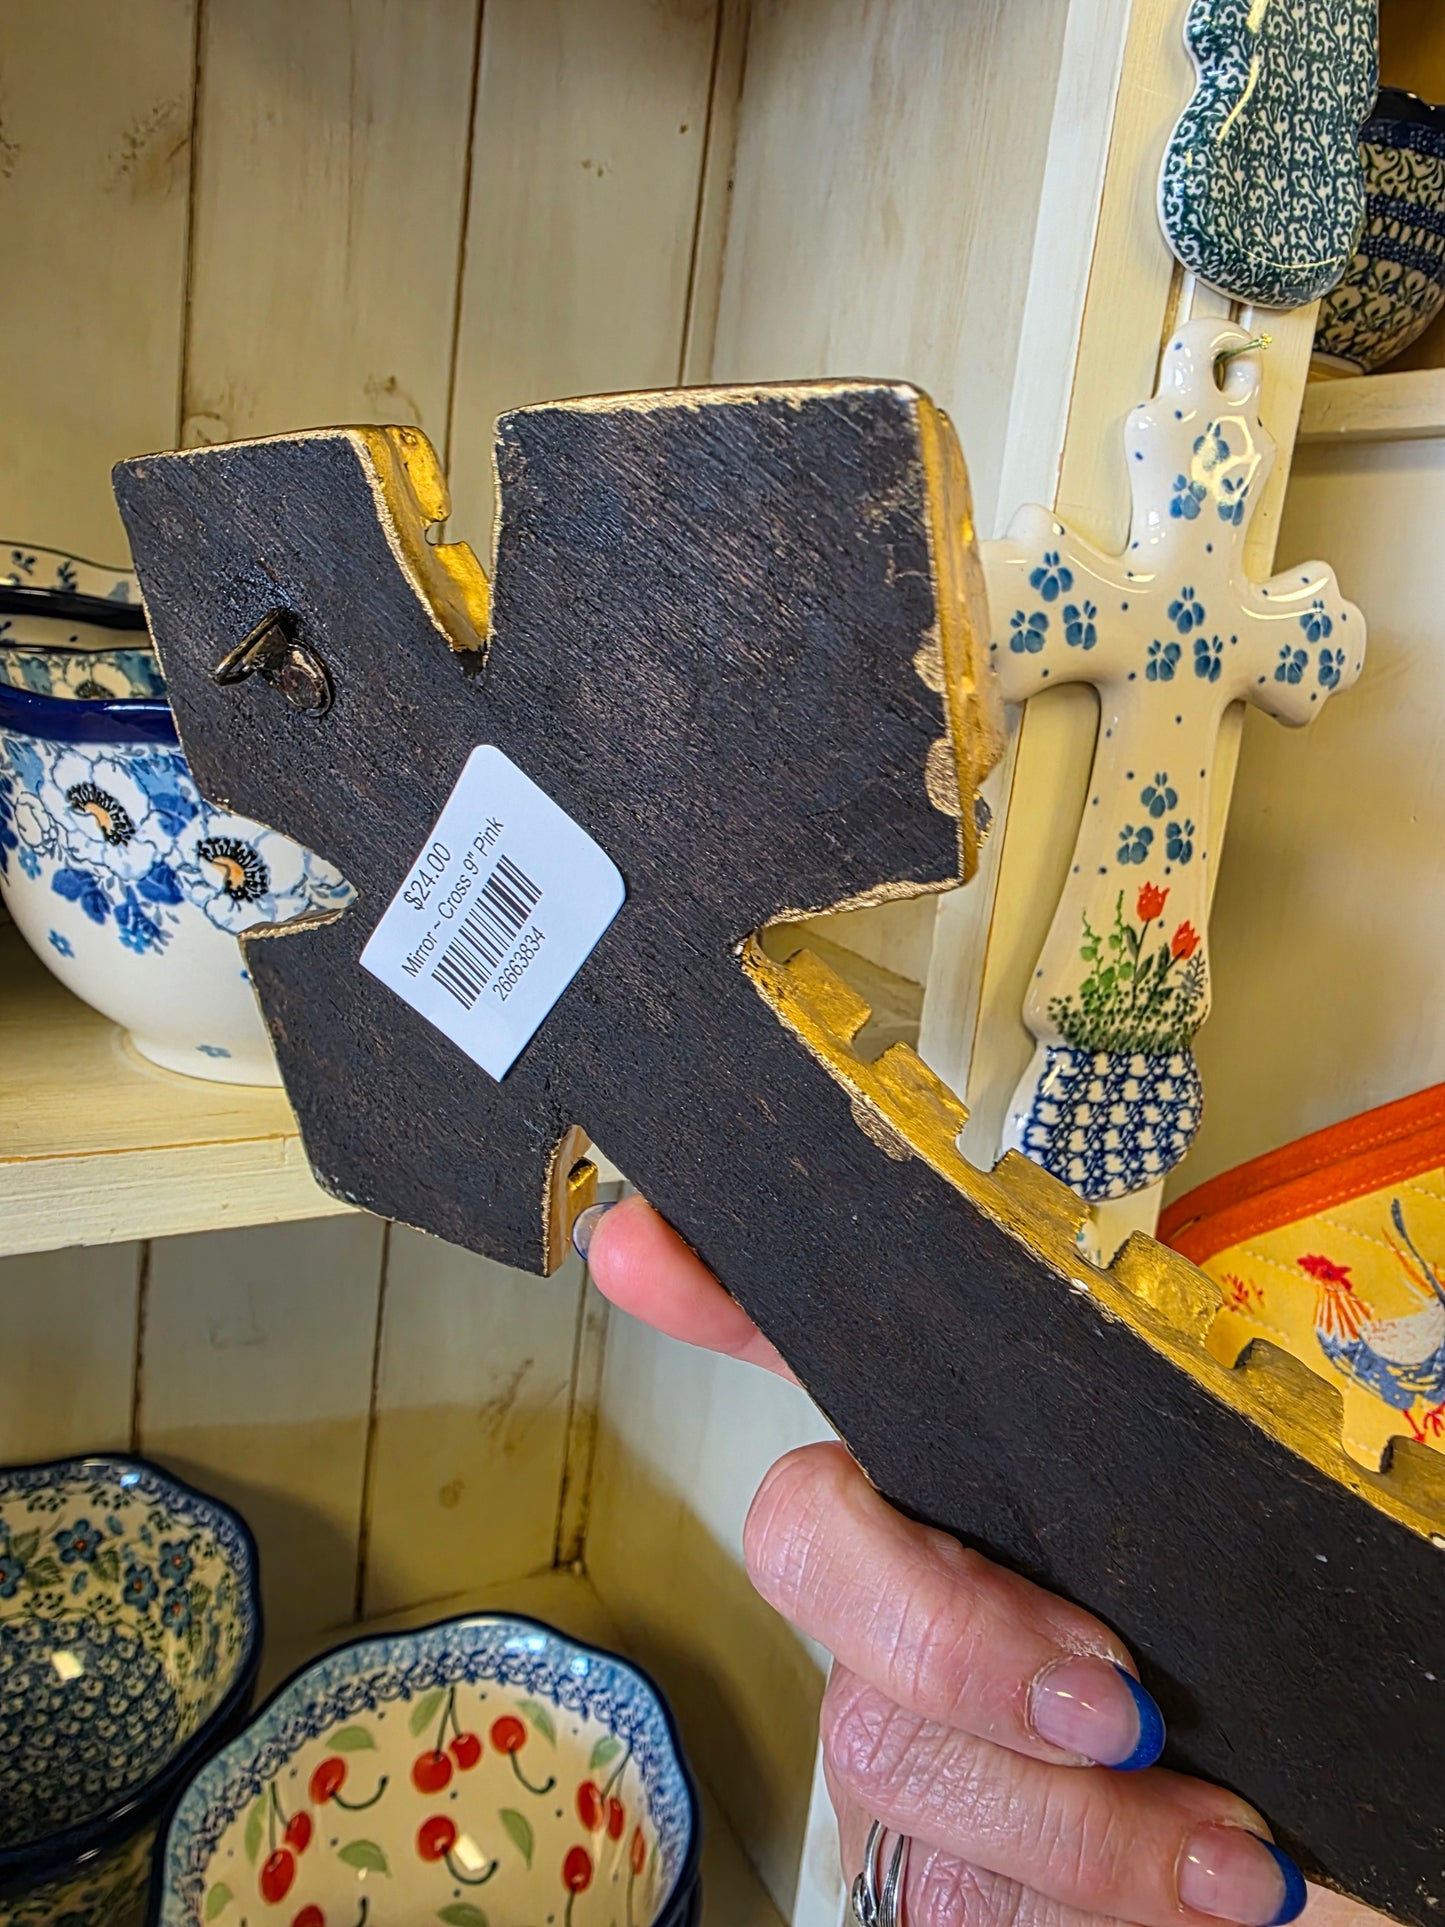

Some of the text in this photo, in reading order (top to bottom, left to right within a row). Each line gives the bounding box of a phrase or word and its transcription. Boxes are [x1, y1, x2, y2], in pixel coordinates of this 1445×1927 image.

[401, 931, 438, 977] Mirror
[437, 874, 472, 919] Cross
[463, 851, 479, 875] 9"
[473, 816, 504, 857] Pink
[403, 842, 451, 910] $24.00
[492, 926, 546, 1001] 26663834
